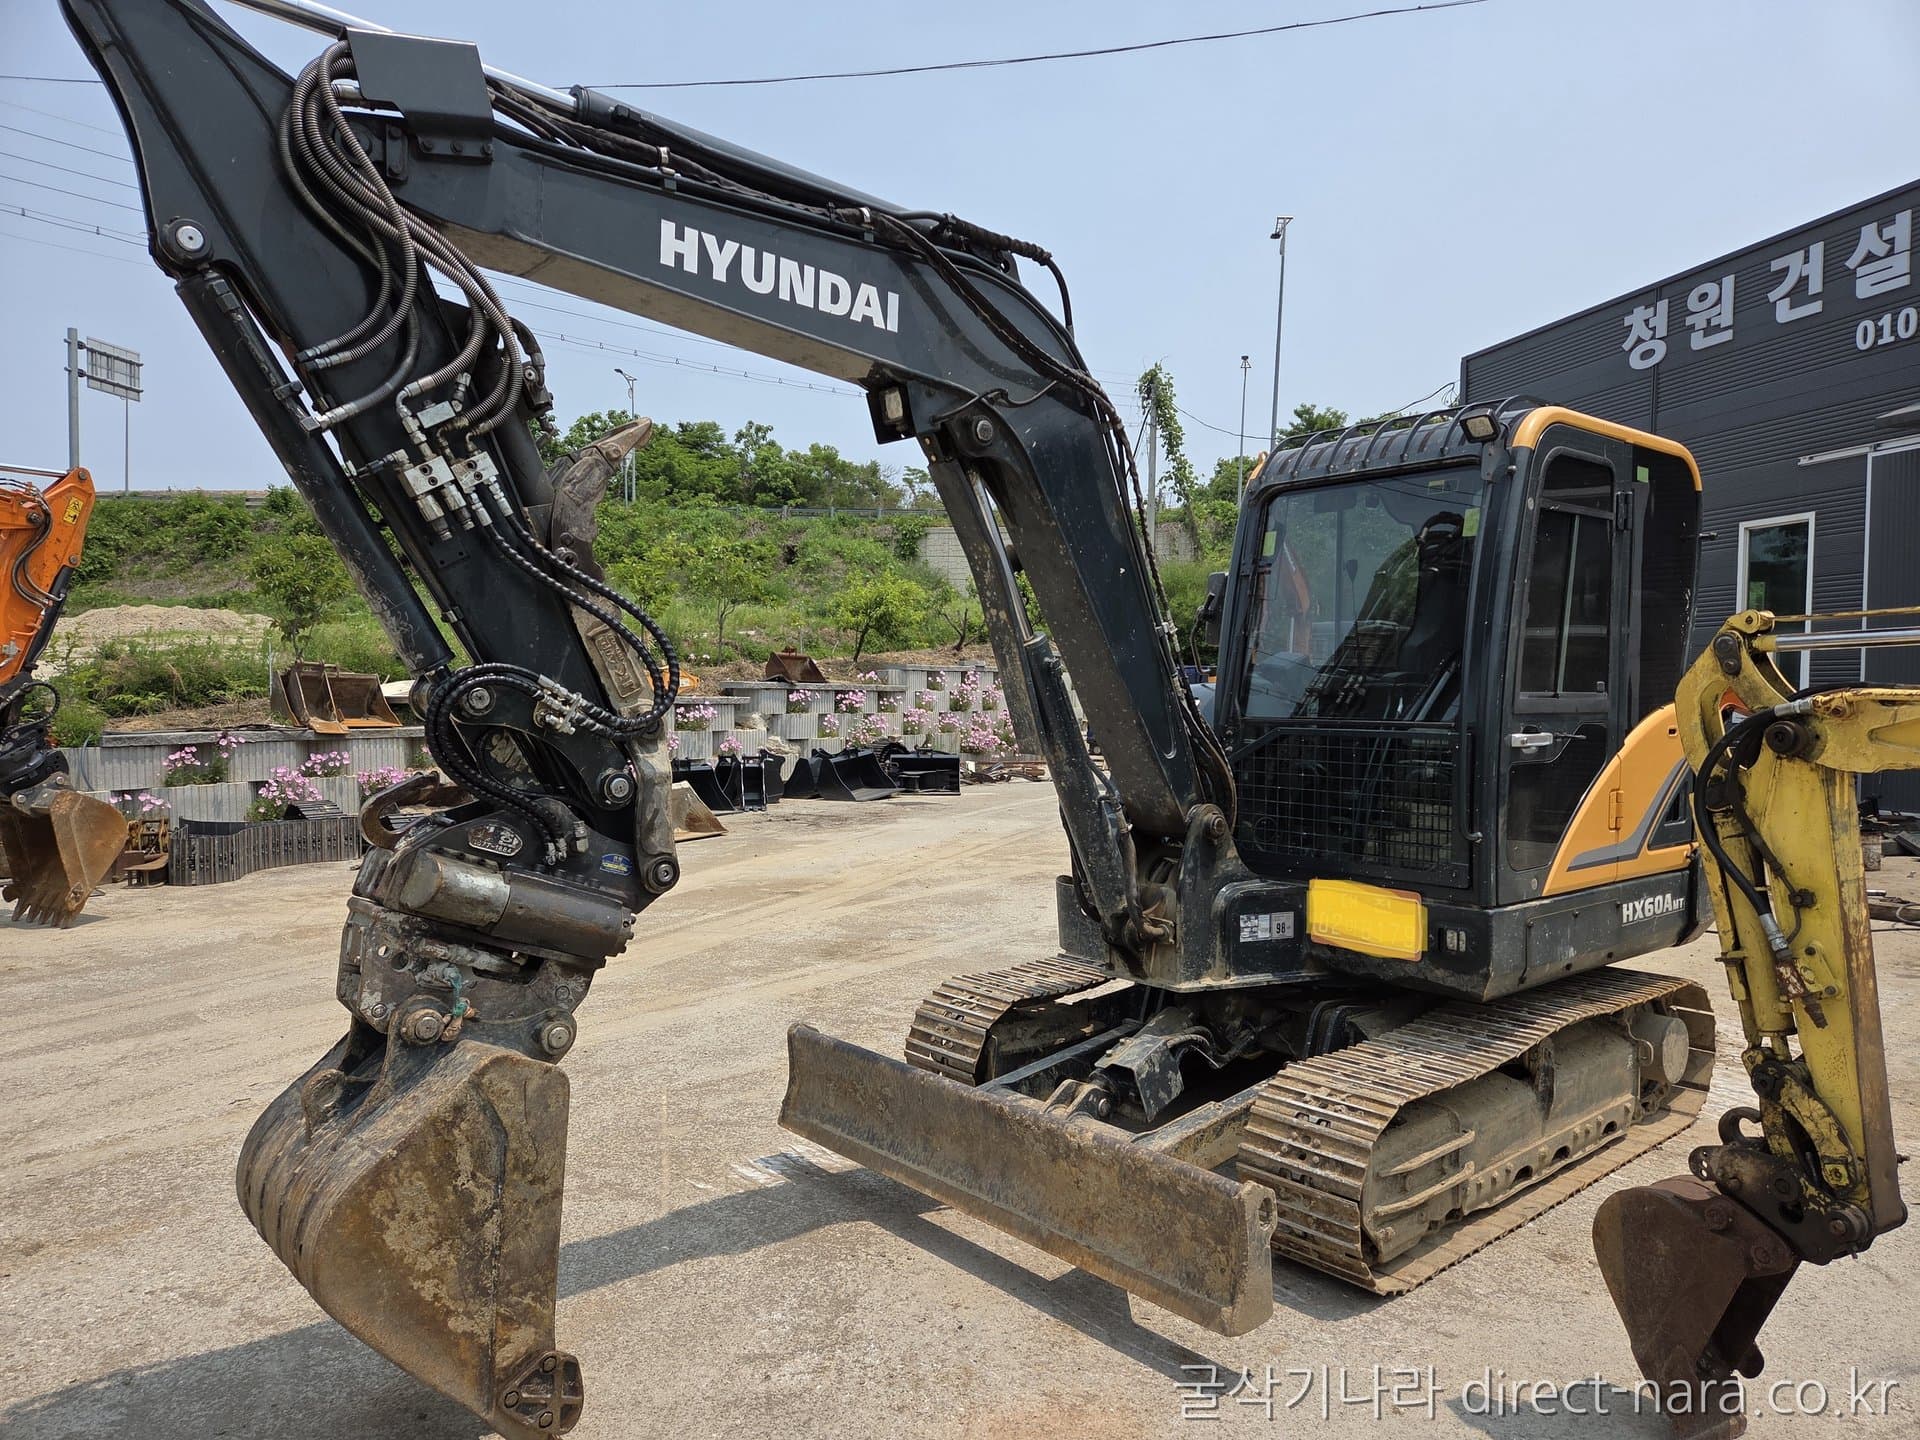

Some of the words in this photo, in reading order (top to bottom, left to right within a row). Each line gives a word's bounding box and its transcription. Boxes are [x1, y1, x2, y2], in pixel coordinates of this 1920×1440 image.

[659, 218, 900, 334] HYUNDAI
[1621, 273, 1737, 371] 청원
[1767, 209, 1913, 324] 건설
[1855, 307, 1919, 351] 010
